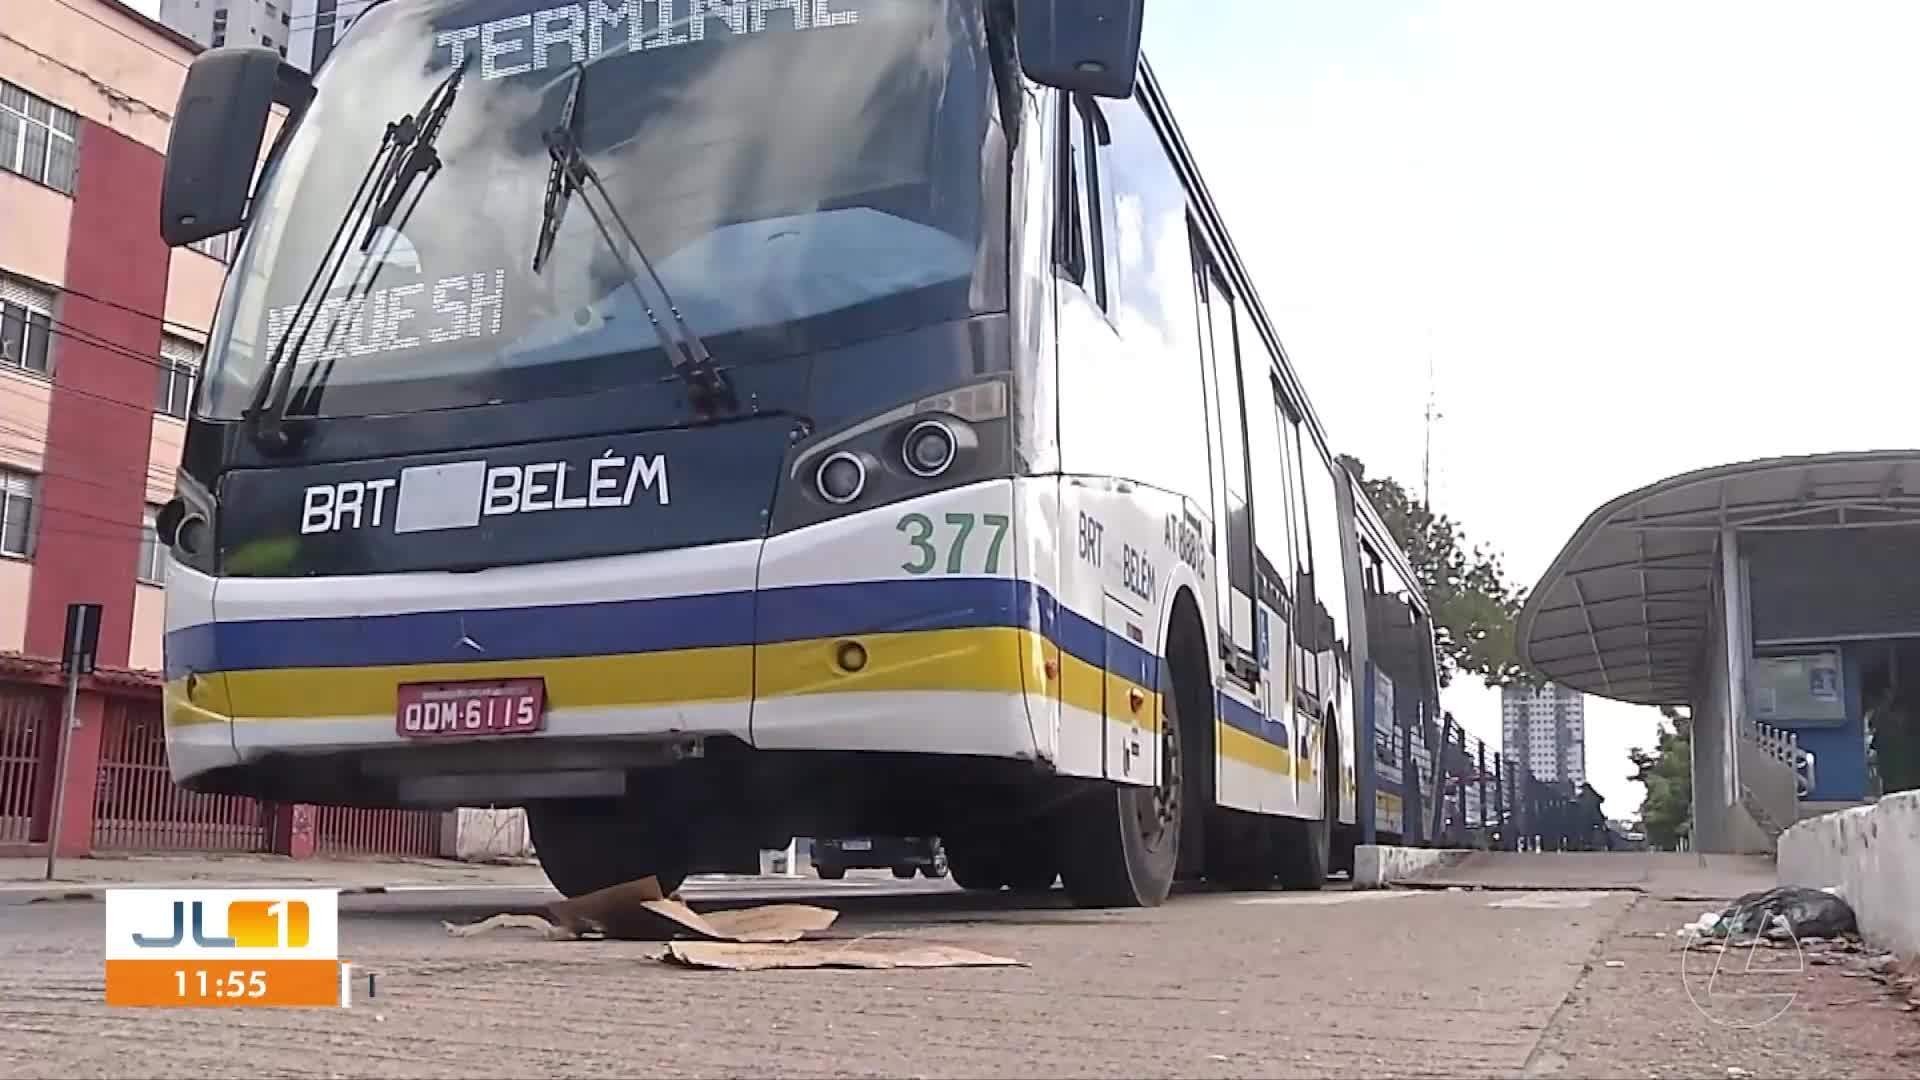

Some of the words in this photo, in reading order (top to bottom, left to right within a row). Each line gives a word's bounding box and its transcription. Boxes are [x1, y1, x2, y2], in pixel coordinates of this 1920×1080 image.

[301, 478, 397, 535] BRT
[483, 448, 670, 516] BELÉM
[896, 512, 1009, 575] 377
[1079, 509, 1104, 569] BRT
[1123, 543, 1157, 605] BELÉM
